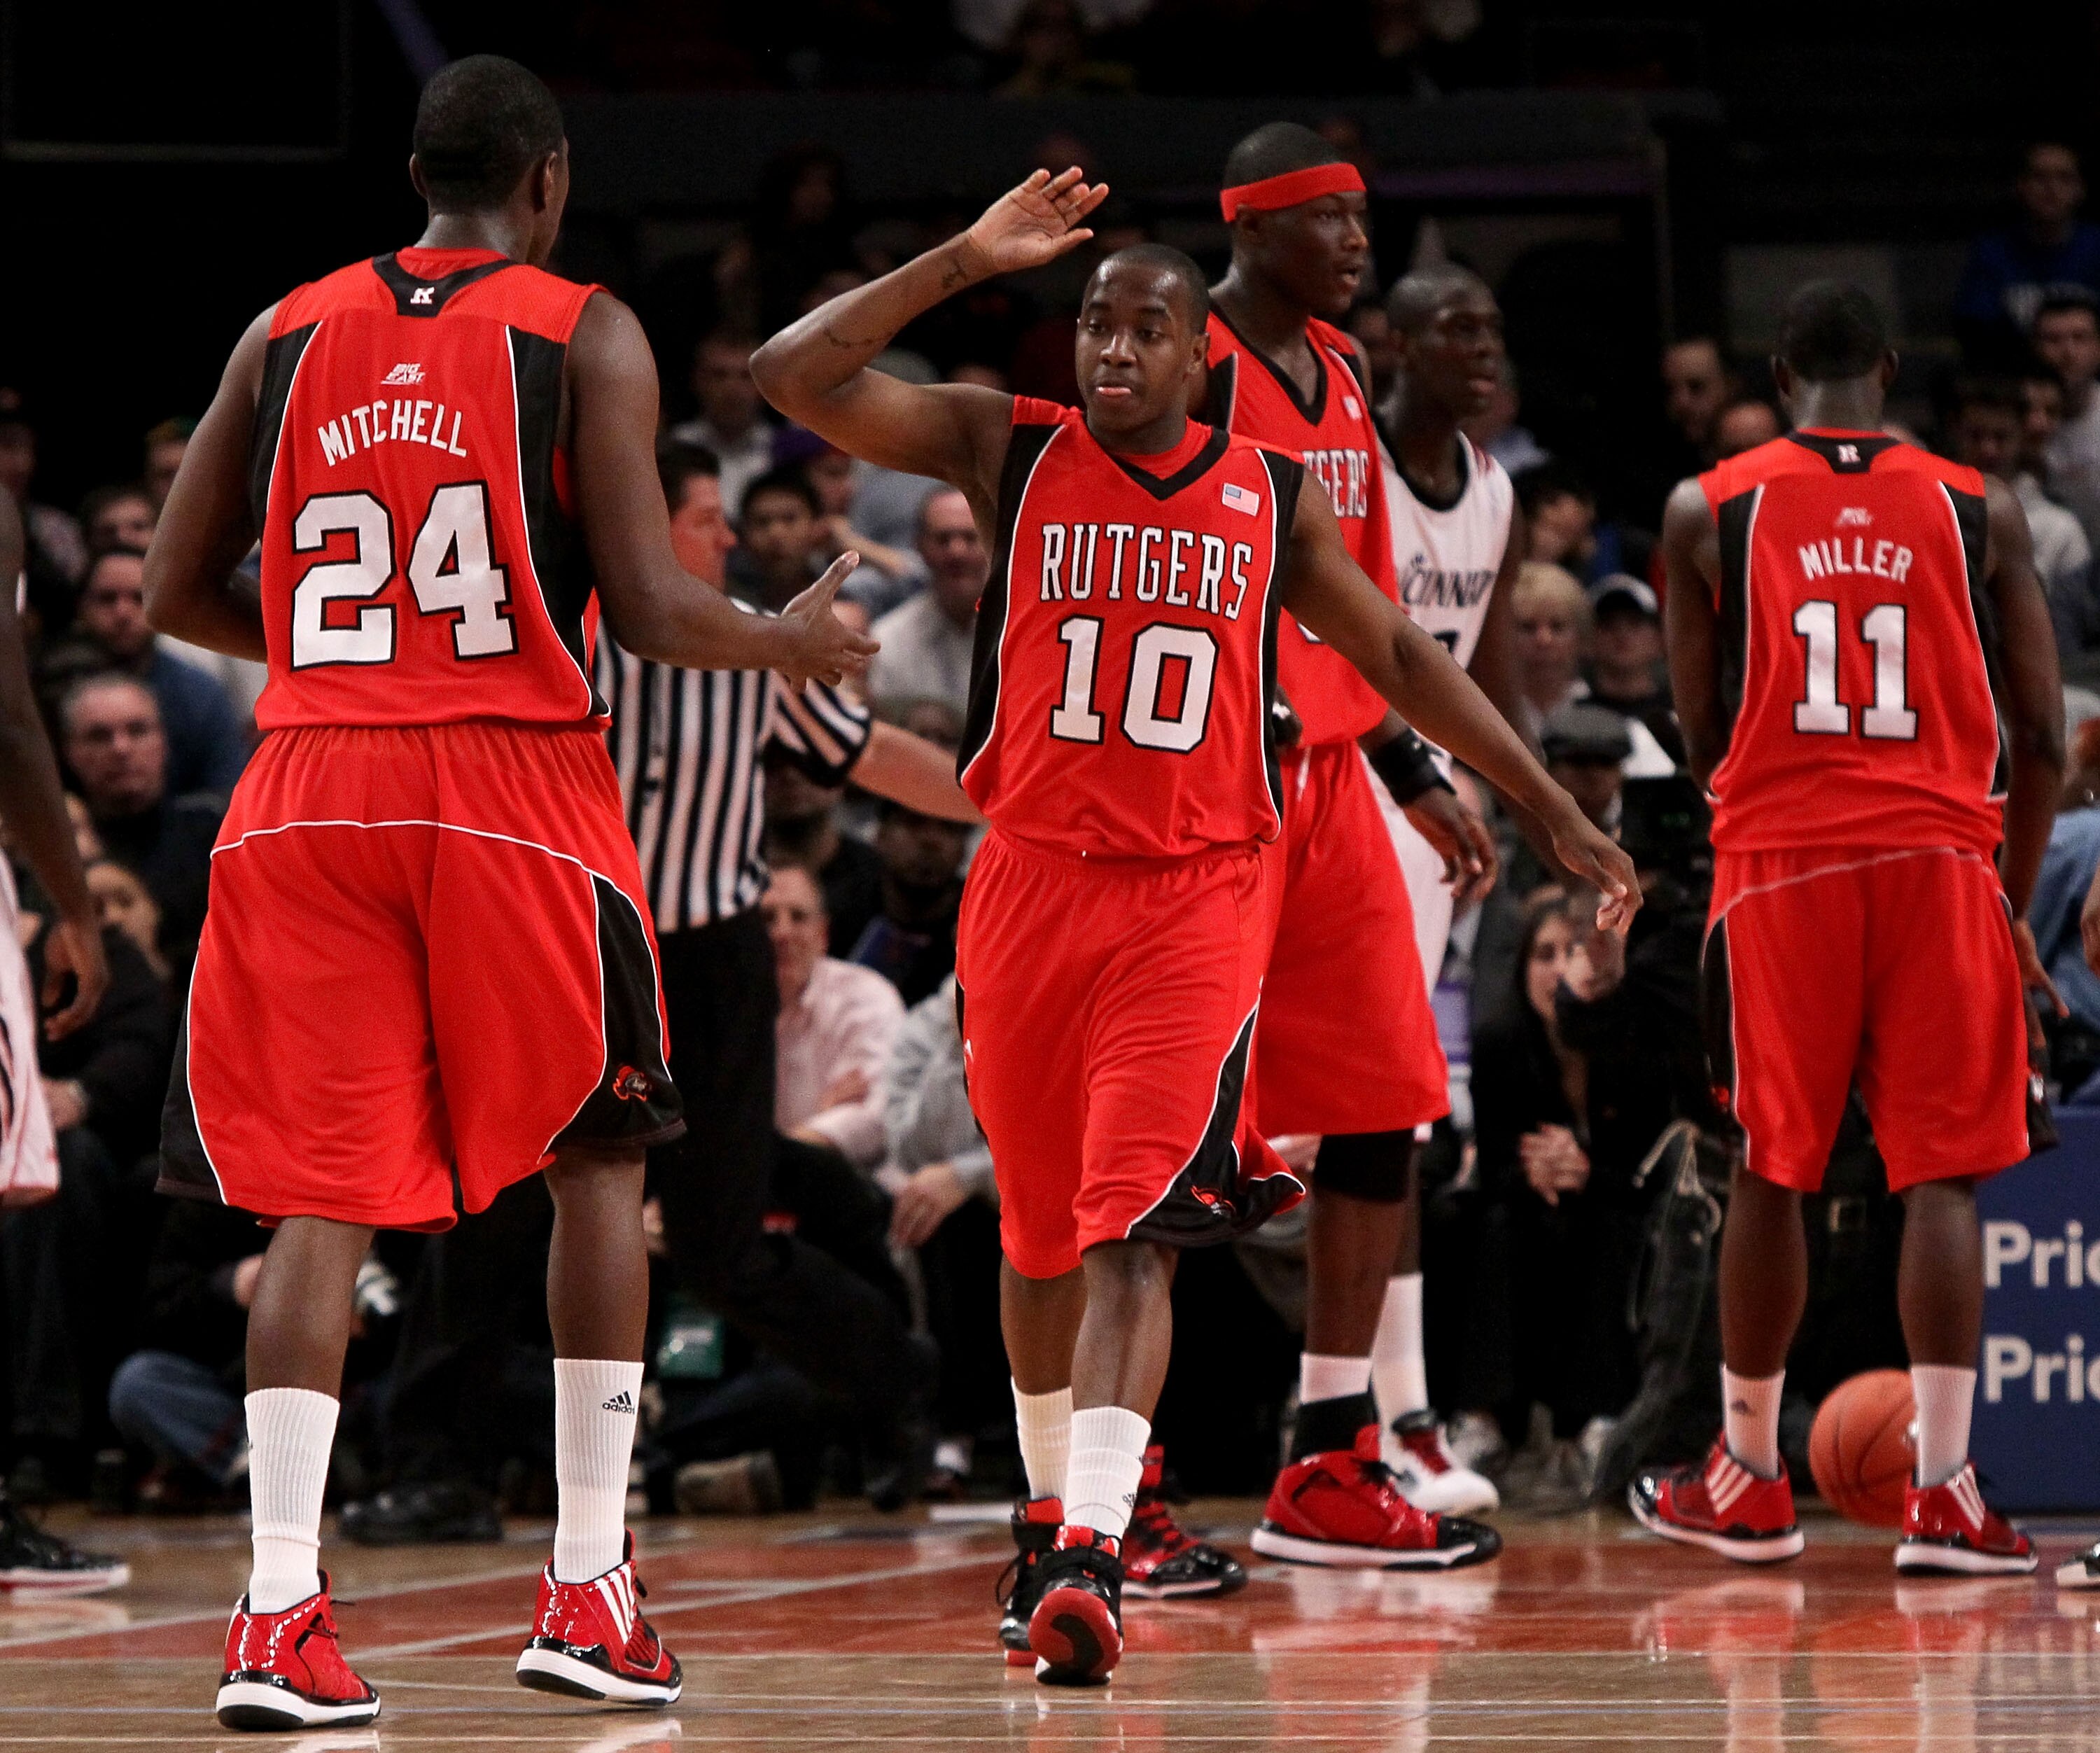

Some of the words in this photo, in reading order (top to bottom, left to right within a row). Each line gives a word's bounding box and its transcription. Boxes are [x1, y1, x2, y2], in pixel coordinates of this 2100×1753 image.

[318, 400, 467, 466] MITCHELL
[290, 480, 519, 671] 24
[1040, 522, 1253, 621] RUTGERS
[1798, 537, 1913, 583] MILLER
[1050, 615, 1218, 754] 10
[1792, 599, 1917, 741] 11
